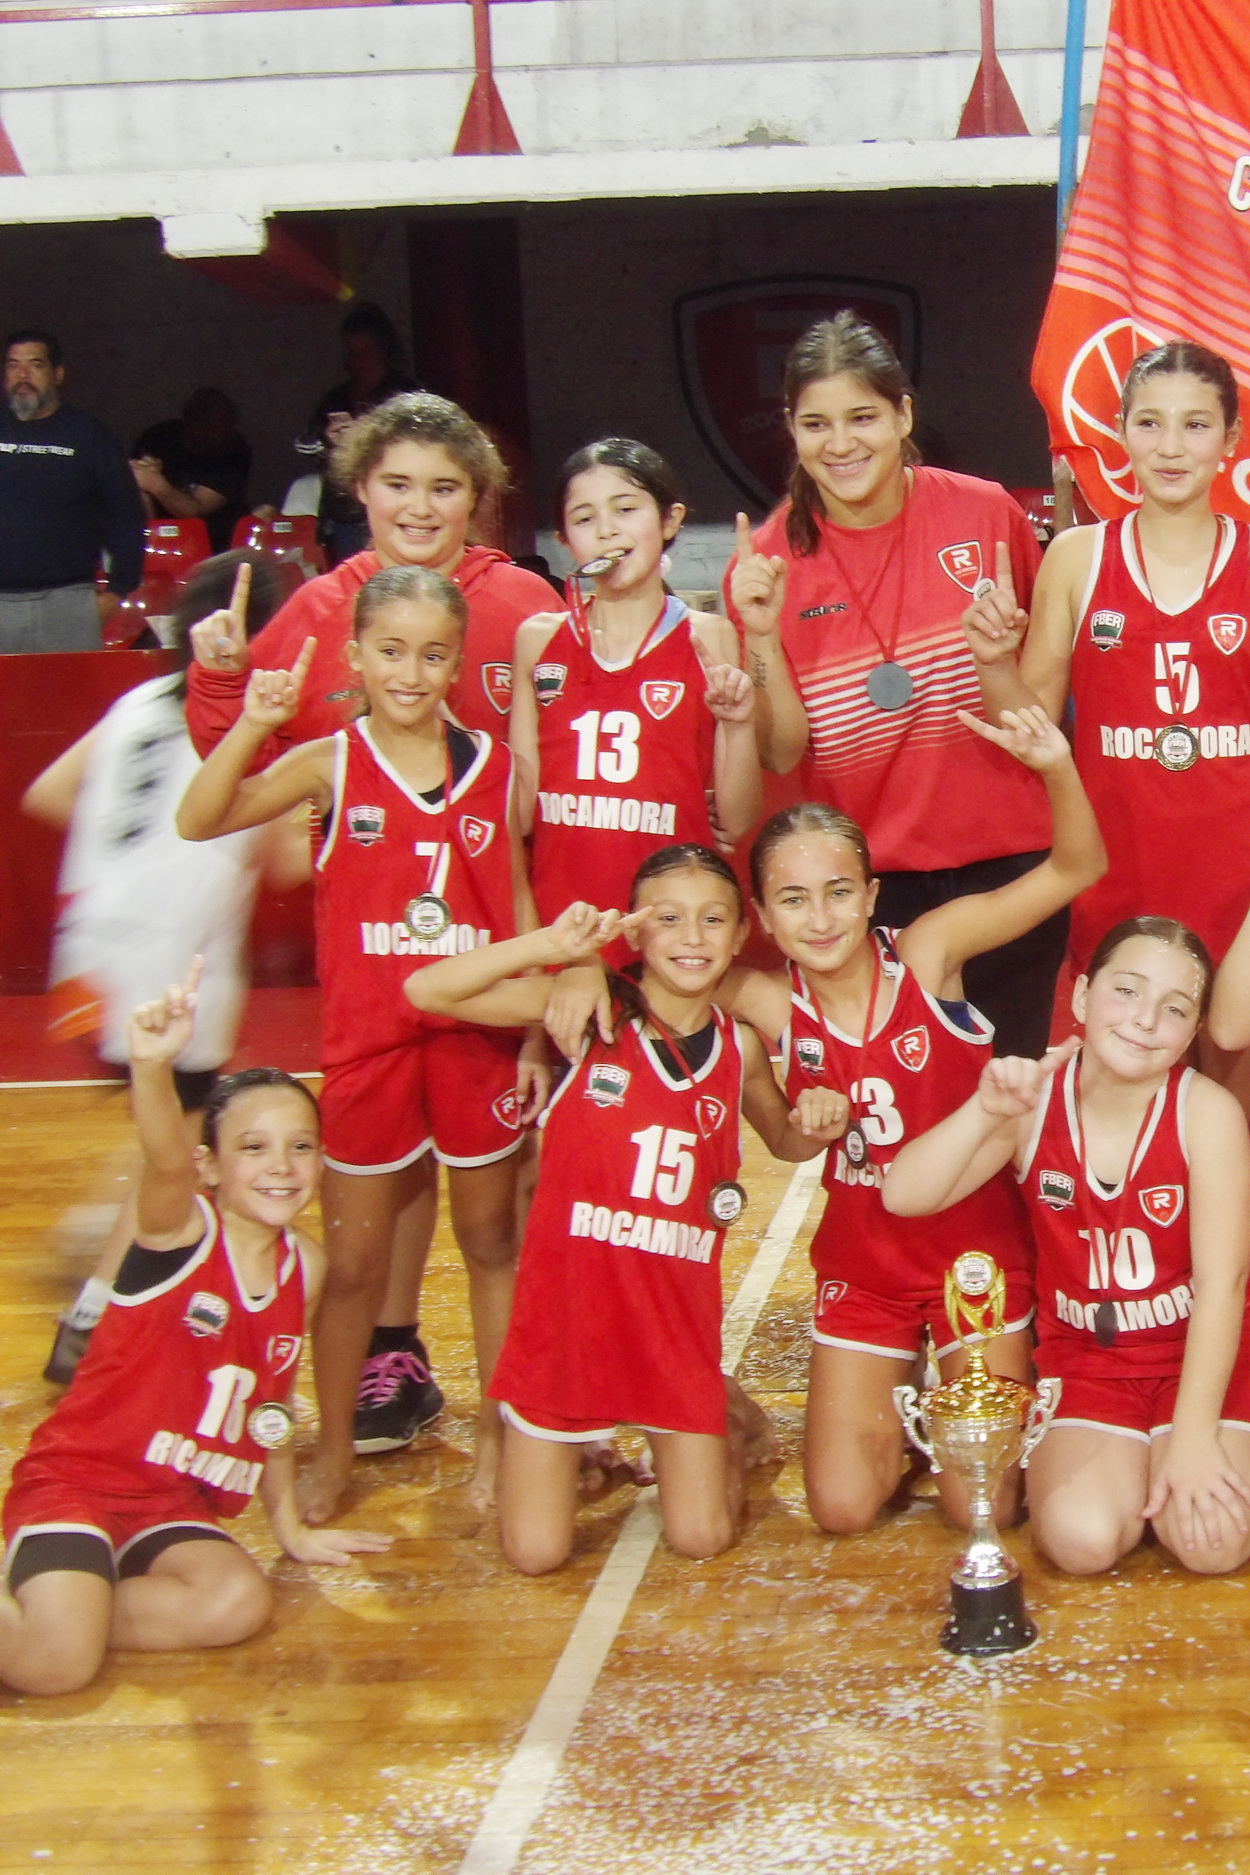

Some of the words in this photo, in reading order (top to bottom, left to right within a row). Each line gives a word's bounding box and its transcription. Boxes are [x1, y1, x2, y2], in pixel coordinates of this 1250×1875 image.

[951, 549, 973, 569] R
[1093, 613, 1122, 629] FBER
[1221, 621, 1237, 636] R
[1155, 642, 1200, 715] 5
[652, 687, 669, 703] R
[570, 711, 641, 783] 13
[415, 842, 450, 898] 7
[904, 1036, 921, 1054] R
[593, 1068, 627, 1085] FBER
[851, 1077, 904, 1146] 3
[631, 1125, 698, 1206] 15
[1042, 1173, 1072, 1191] FBER
[1153, 1193, 1171, 1209] R
[570, 1202, 717, 1264] ROCAMORA
[1078, 1227, 1155, 1290] 10
